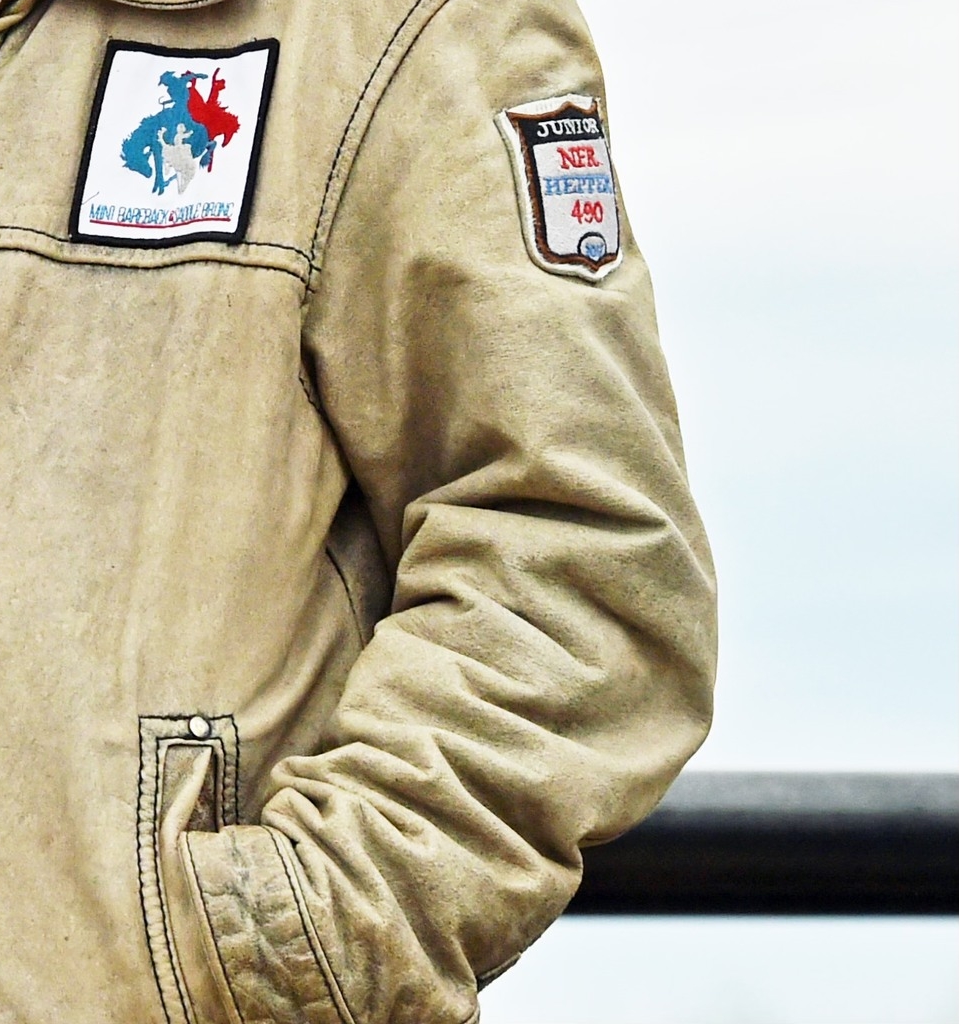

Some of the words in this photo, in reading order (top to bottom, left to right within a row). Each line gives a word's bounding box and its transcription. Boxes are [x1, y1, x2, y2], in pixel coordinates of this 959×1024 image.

[537, 118, 600, 137] JUNIOR
[557, 146, 603, 169] NFR
[571, 199, 604, 224] 490
